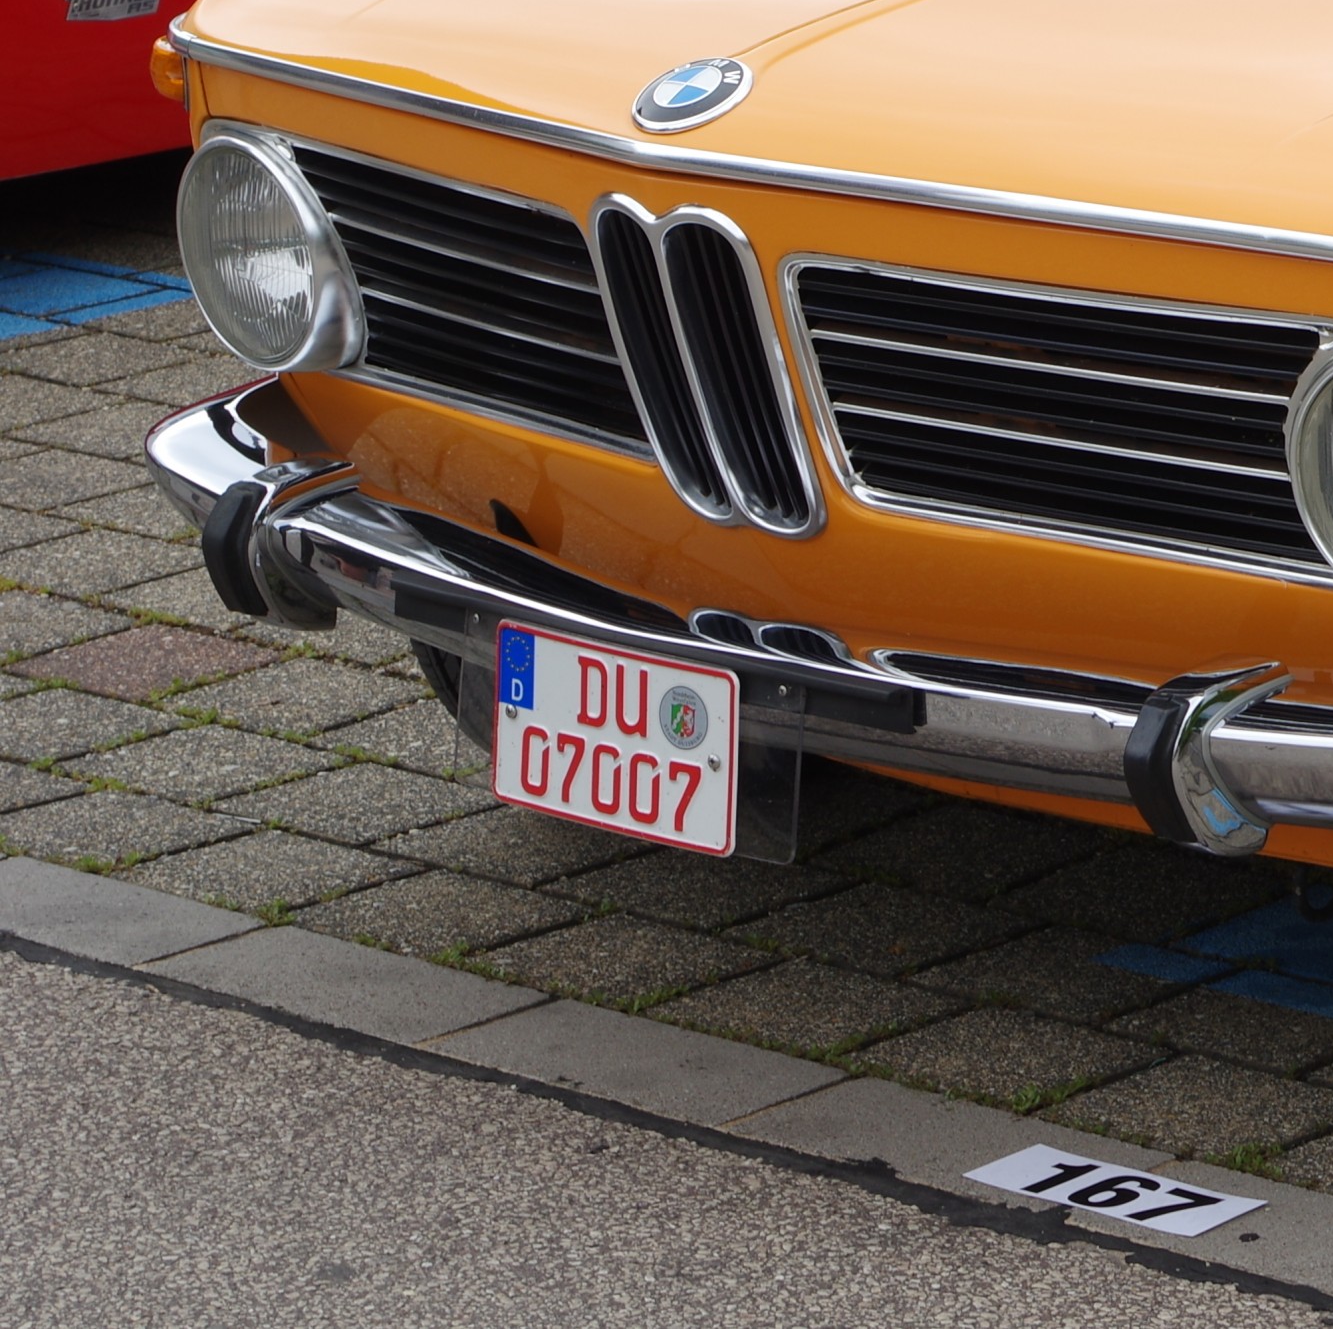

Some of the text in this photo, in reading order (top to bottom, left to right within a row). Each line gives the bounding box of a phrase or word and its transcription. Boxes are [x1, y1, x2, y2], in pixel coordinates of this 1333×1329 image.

[511, 678, 523, 701] D
[577, 655, 648, 738] DU
[520, 725, 702, 832] 07007
[1019, 1162, 1226, 1221] 167
